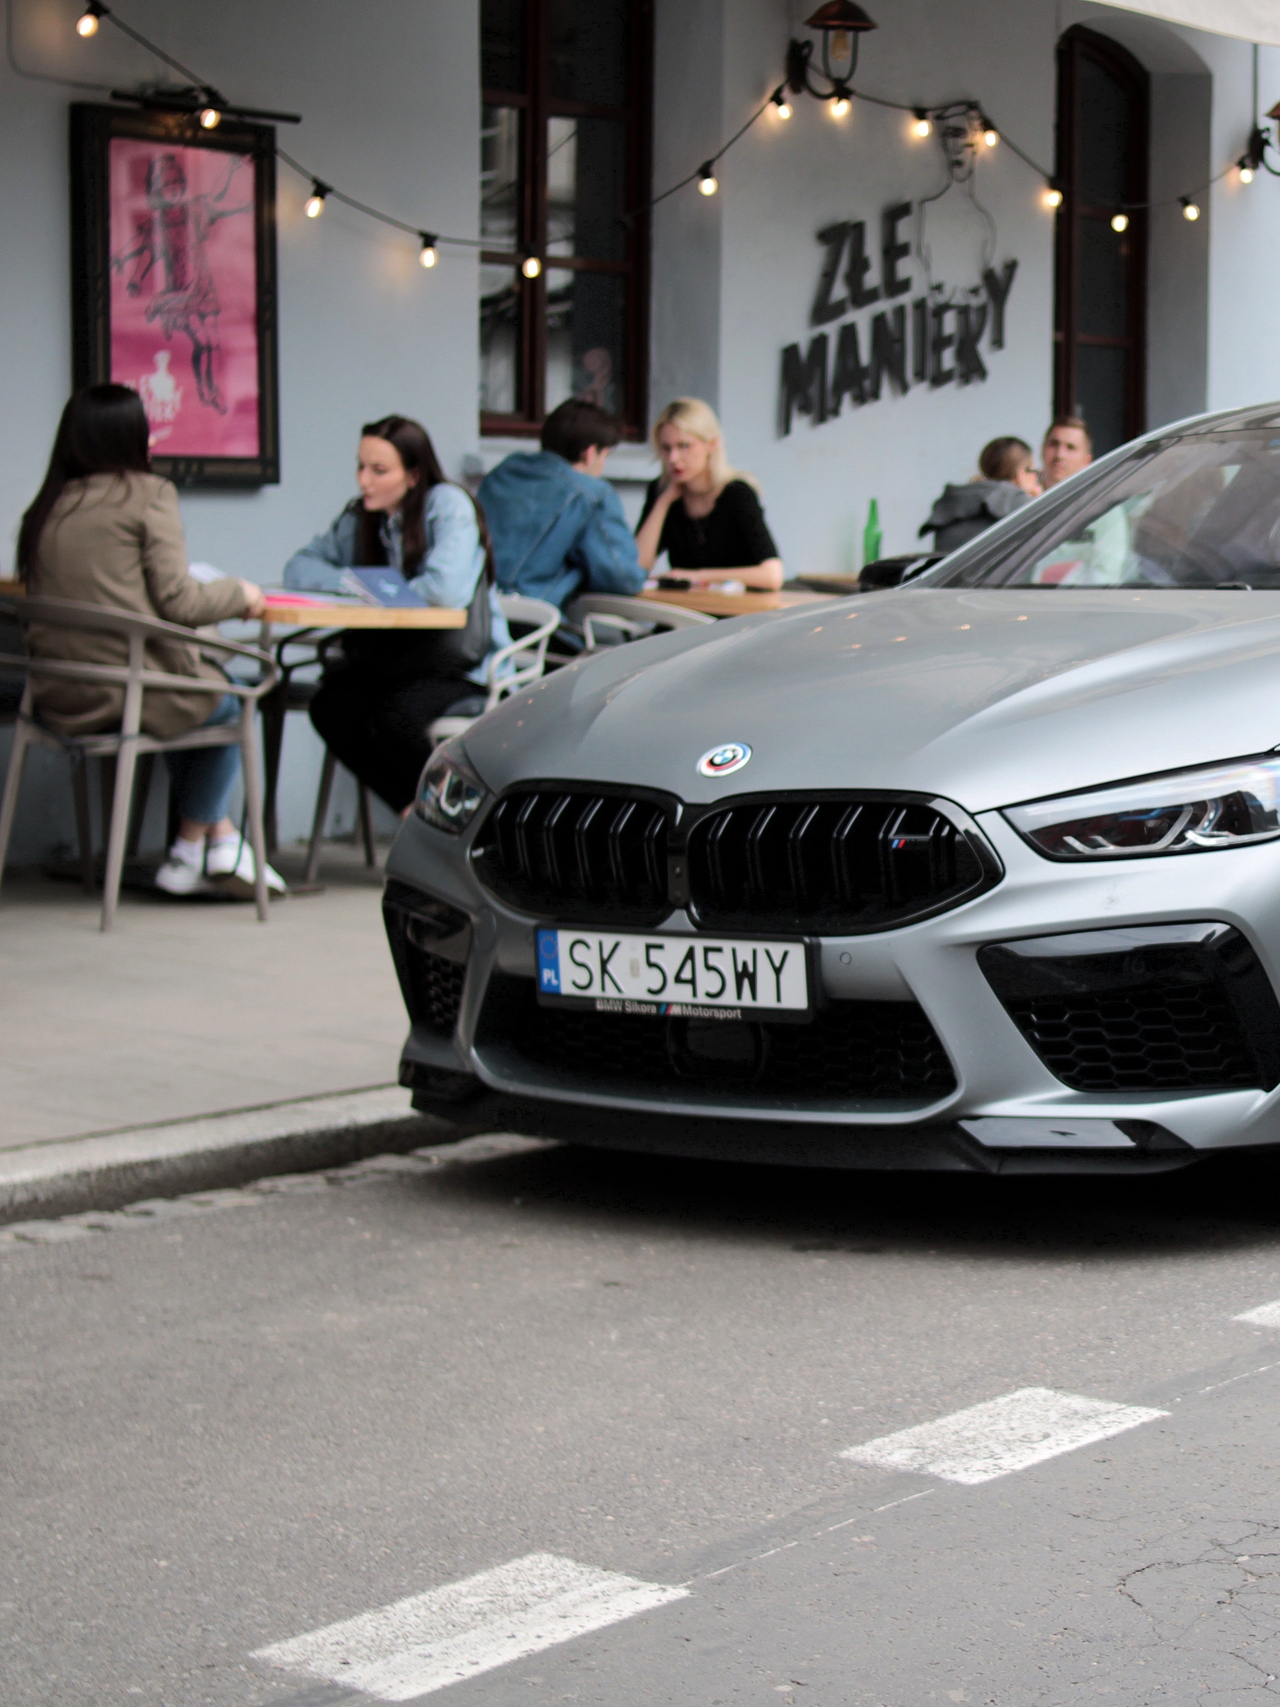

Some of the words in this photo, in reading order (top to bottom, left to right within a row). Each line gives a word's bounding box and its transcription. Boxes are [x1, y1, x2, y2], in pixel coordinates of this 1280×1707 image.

[810, 200, 912, 329] ZŁE
[778, 258, 1019, 440] MANIERY
[543, 968, 559, 986] PL
[569, 939, 624, 994] SK
[645, 943, 789, 1003] 545WY
[595, 998, 623, 1012] BMW
[625, 1001, 657, 1014] Sikora
